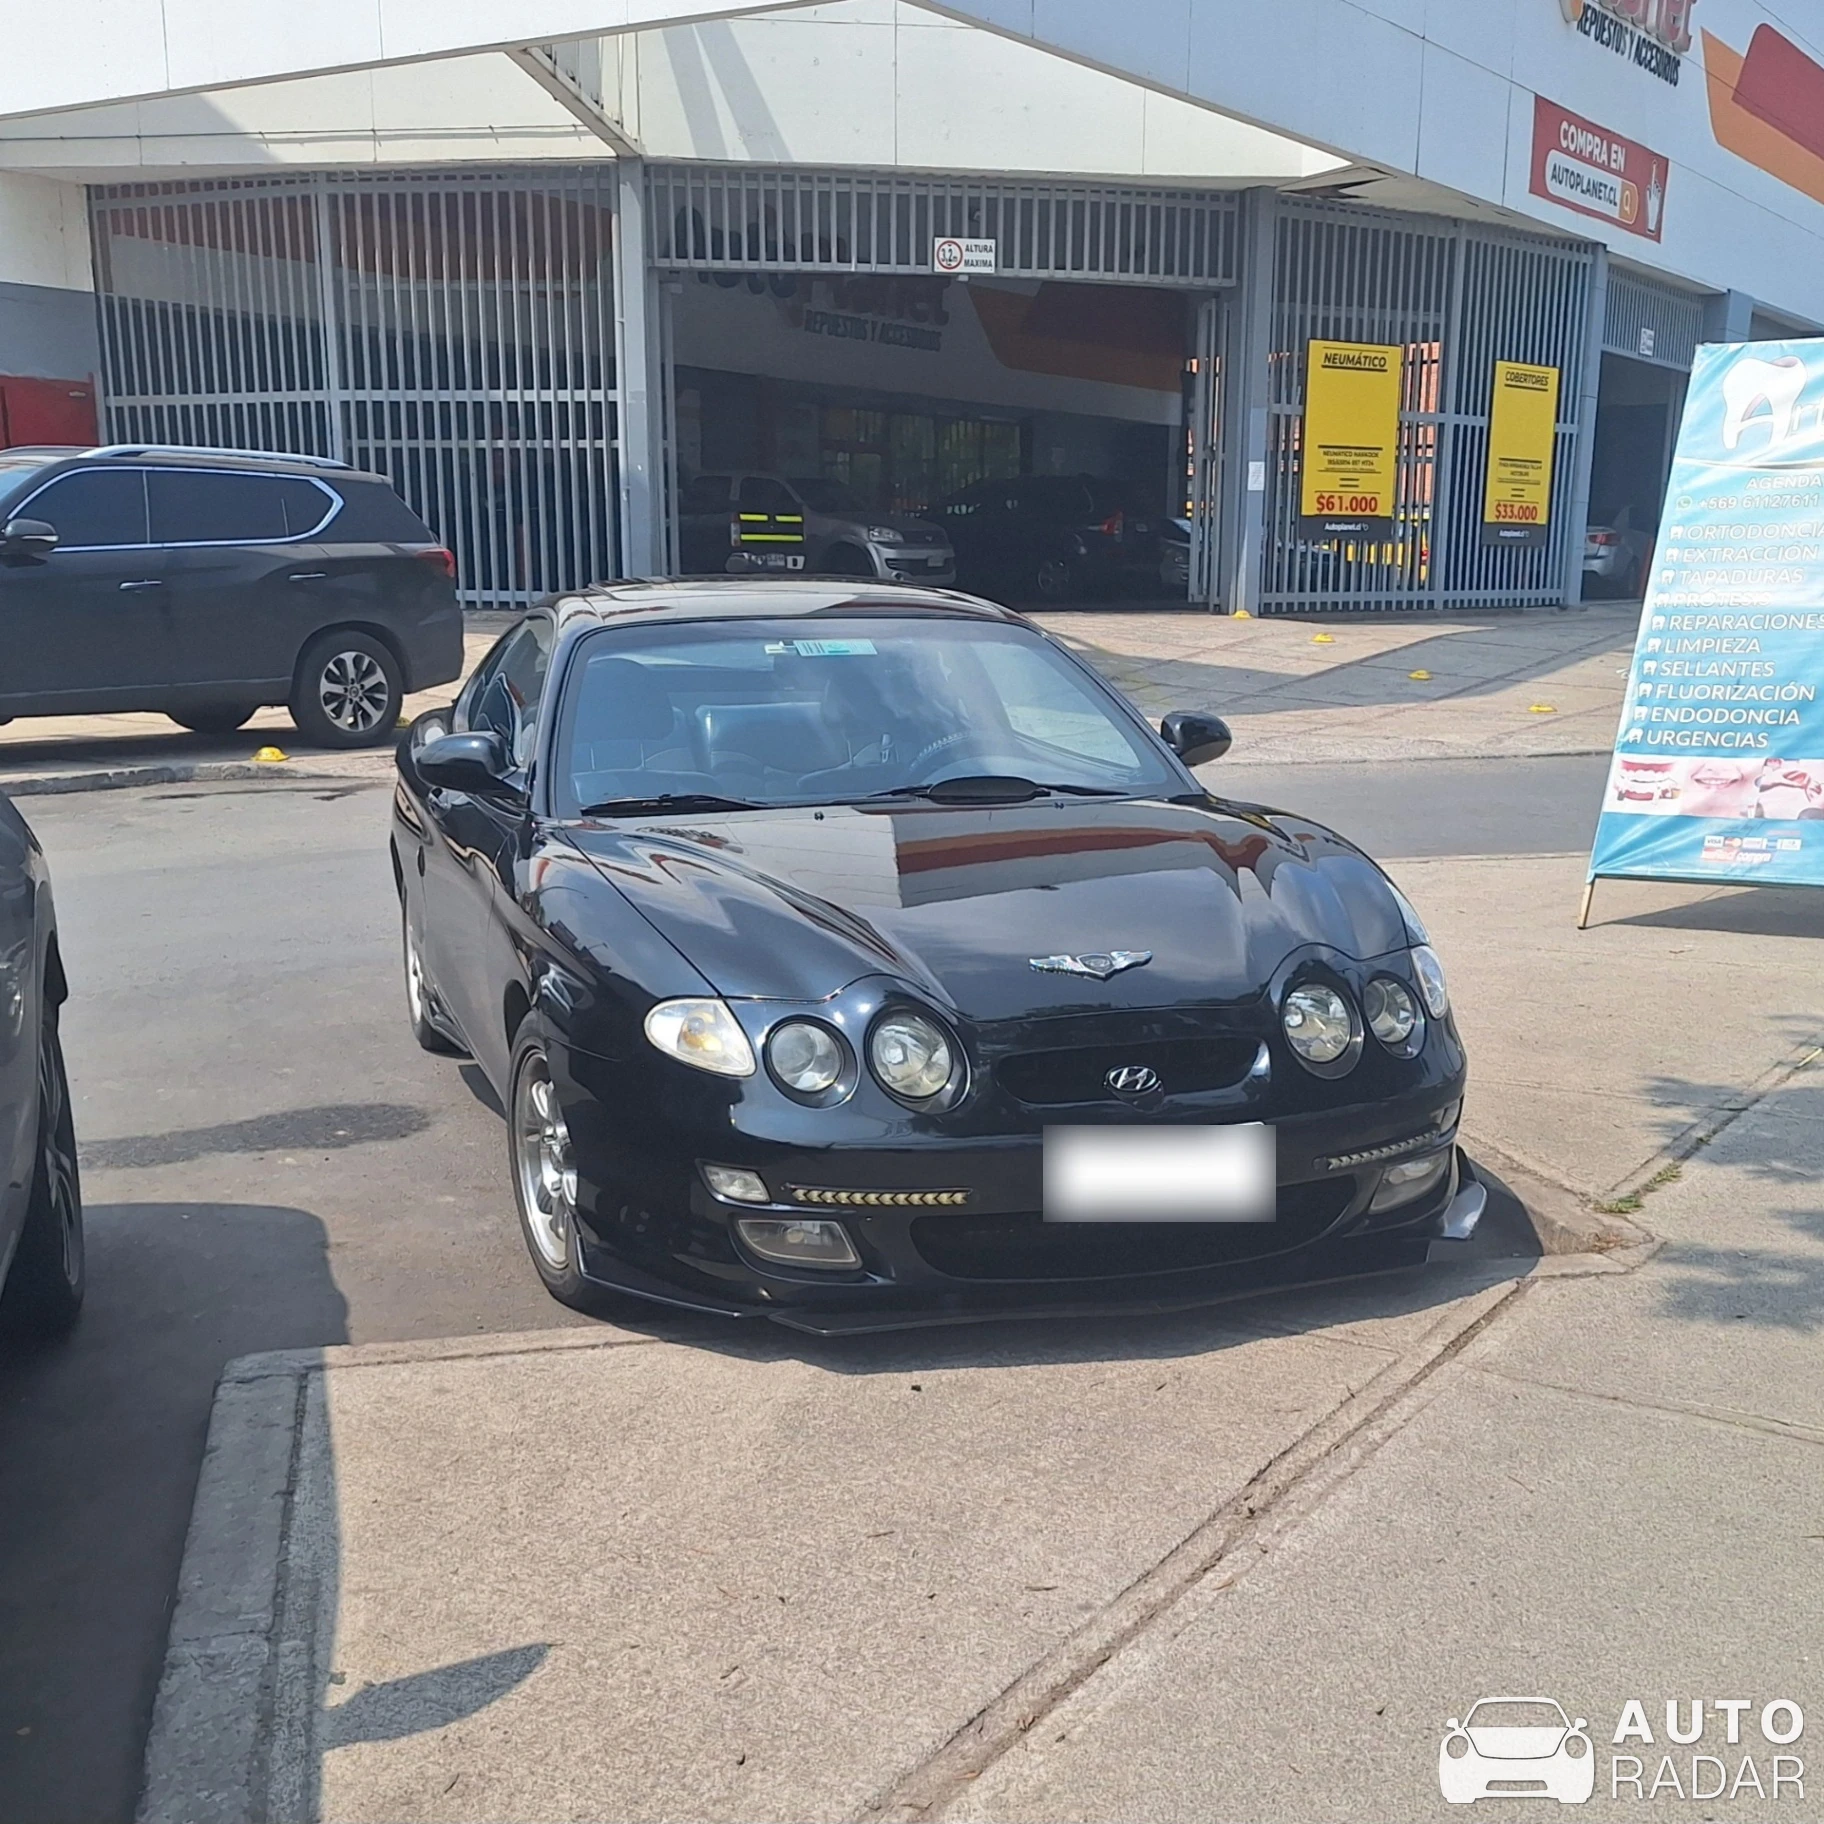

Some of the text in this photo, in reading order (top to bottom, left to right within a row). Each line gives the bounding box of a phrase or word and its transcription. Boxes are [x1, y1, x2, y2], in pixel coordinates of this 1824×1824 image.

[1577, 3, 1629, 57] REPUESTOS
[1627, 29, 1637, 60] Y
[1633, 35, 1681, 87] ACCESORIOS
[1560, 120, 1626, 172] COMPRA EN
[1551, 163, 1618, 207] AUTOPLANET.CL
[965, 244, 993, 253] ALTURA
[964, 259, 993, 268] MAXIMA
[871, 320, 879, 341] Y
[1323, 352, 1387, 368] NEUMÁTICO
[1505, 371, 1549, 386] COBERTORES
[1746, 475, 1823, 490] AGENDA
[1316, 493, 1378, 514] $61.000
[1700, 493, 1820, 510] +569 61127611
[1495, 503, 1538, 521] $33.000
[1682, 542, 1819, 563] EXTRACCIÓN
[1680, 568, 1805, 585] TAPADURAS
[1669, 613, 1824, 631] REPARACIONES
[1665, 638, 1761, 653] LIMPIEZA
[1660, 661, 1775, 677] SELLANTES
[1655, 681, 1816, 701] FLUORIZACIÓN
[1651, 707, 1800, 725] ENDODONCIA
[1646, 731, 1769, 748] URGENCIAS
